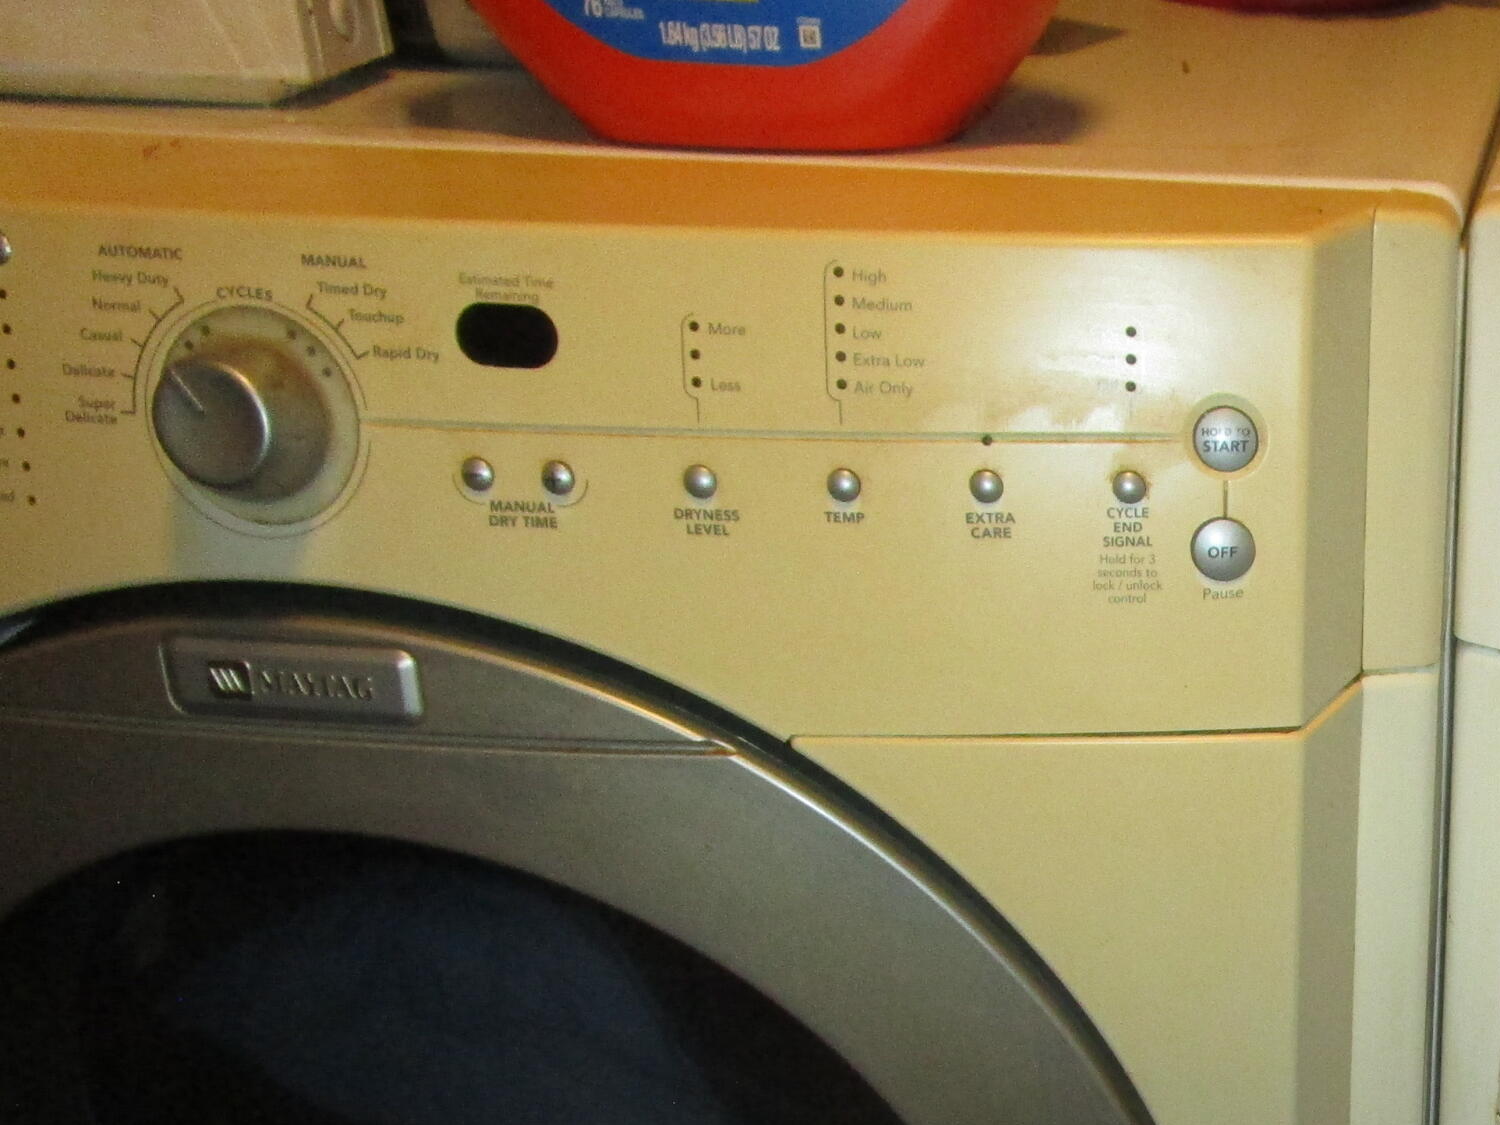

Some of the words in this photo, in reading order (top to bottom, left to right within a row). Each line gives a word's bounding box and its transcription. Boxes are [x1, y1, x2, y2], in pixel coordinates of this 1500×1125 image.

[98, 245, 183, 261] AUTOMATIC
[301, 254, 367, 269] MANUAL
[92, 270, 133, 287] Heavy
[137, 272, 169, 287] Duty
[459, 273, 520, 288] Estimated
[524, 276, 554, 289] Time
[852, 268, 887, 285] High
[216, 286, 273, 301] CYCLES
[317, 281, 358, 297] Timed
[362, 284, 388, 299] Dry
[92, 297, 141, 313] Normal
[852, 297, 913, 313] Medium
[349, 309, 404, 324] Touchup
[80, 328, 123, 342] Casual
[708, 322, 746, 337] More
[852, 326, 882, 341] Low
[373, 346, 411, 361] Rapid
[416, 347, 440, 362] Dry
[853, 353, 889, 368] Extra
[894, 354, 925, 369] Low
[62, 364, 115, 378] Delicate
[711, 378, 742, 393] Less
[854, 380, 875, 395] Air
[880, 381, 914, 398] Only
[78, 396, 116, 411] Super
[65, 410, 118, 425] Delicate
[1203, 440, 1250, 453] START
[490, 500, 555, 514] MANUAL
[1106, 507, 1150, 519] CYCLE
[488, 515, 520, 529] DRY
[525, 515, 558, 529] TIME
[674, 508, 740, 522] DRYNESS
[824, 510, 866, 524] TEMP
[965, 511, 1016, 525] EXTRA
[686, 523, 730, 537] LEVEL
[971, 526, 1013, 539] CARE
[1113, 522, 1143, 533] END
[1103, 536, 1153, 547] SIGNAL
[1100, 554, 1127, 565] Hold
[1130, 554, 1145, 565] for
[1149, 554, 1156, 565] 3
[1208, 546, 1239, 559] OFF
[1098, 567, 1142, 578] seconds
[1145, 568, 1158, 578] to
[1093, 581, 1115, 591] lock
[1126, 581, 1163, 591] unlock
[1108, 593, 1147, 604] control
[1203, 587, 1245, 601] Pause
[258, 670, 374, 701] MAYTAG
